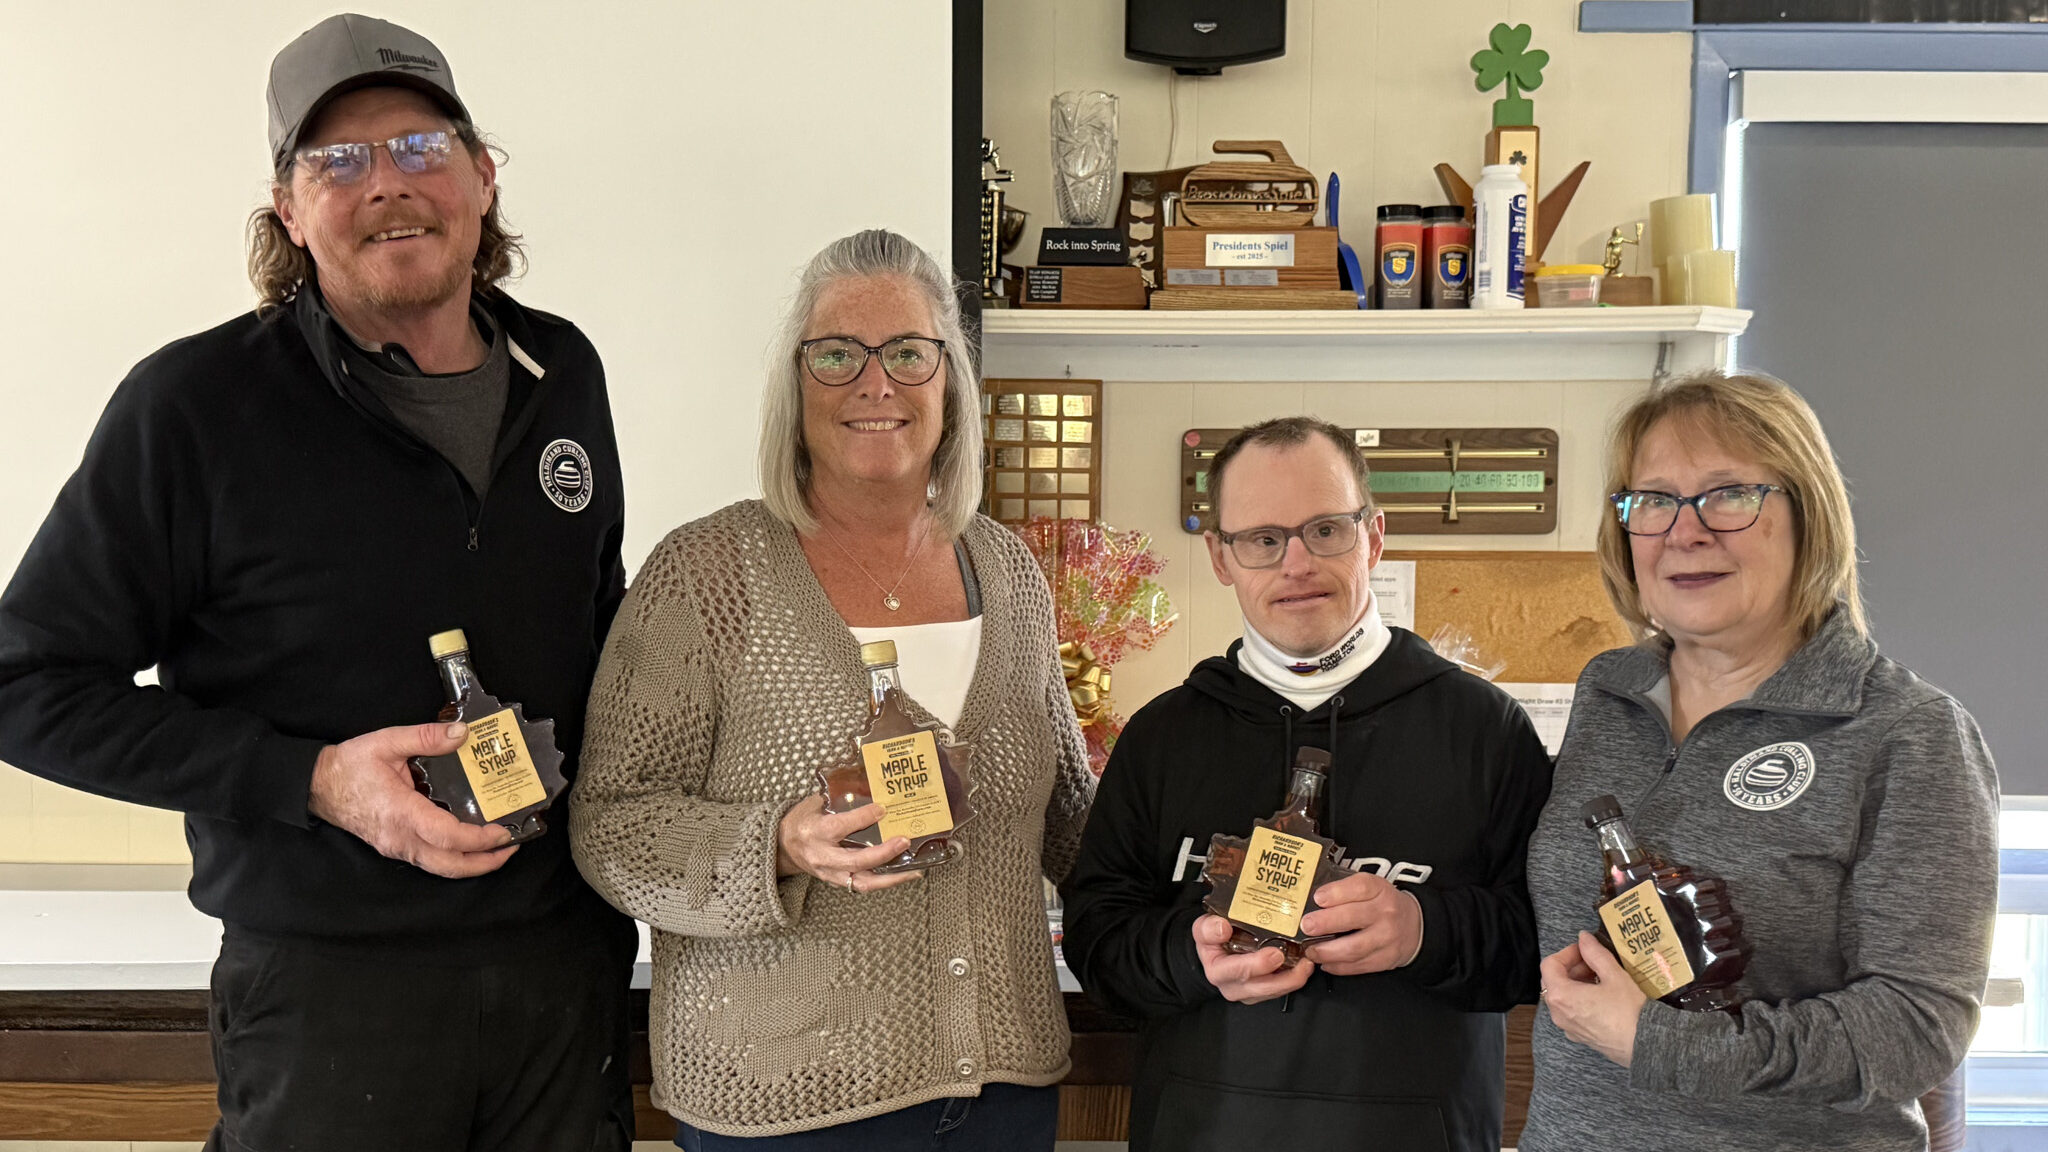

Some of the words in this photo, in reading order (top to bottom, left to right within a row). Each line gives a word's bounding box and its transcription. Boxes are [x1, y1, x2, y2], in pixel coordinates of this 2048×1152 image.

[376, 48, 438, 67] Milwaukee
[1046, 240, 1069, 250] Rock
[1071, 240, 1089, 250] into
[1091, 240, 1120, 252] Spring
[1212, 241, 1262, 250] Presidents
[1264, 241, 1288, 252] Spiel
[562, 444, 587, 468] CURLING
[564, 494, 586, 506] YEARS
[1340, 628, 1364, 651] WORLDS
[471, 732, 514, 760] MAPLE
[479, 750, 516, 774] SYRUP
[880, 754, 928, 779] MAPLE
[1779, 746, 1807, 770] CURLING
[886, 773, 928, 795] SYRUP
[1786, 772, 1806, 792] CLUB
[1741, 792, 1782, 805] YEARS
[1259, 849, 1304, 876] MAPLE
[1256, 867, 1298, 889] SYRUP
[1618, 906, 1656, 940] MAPLE
[1627, 925, 1661, 955] SYRUP
